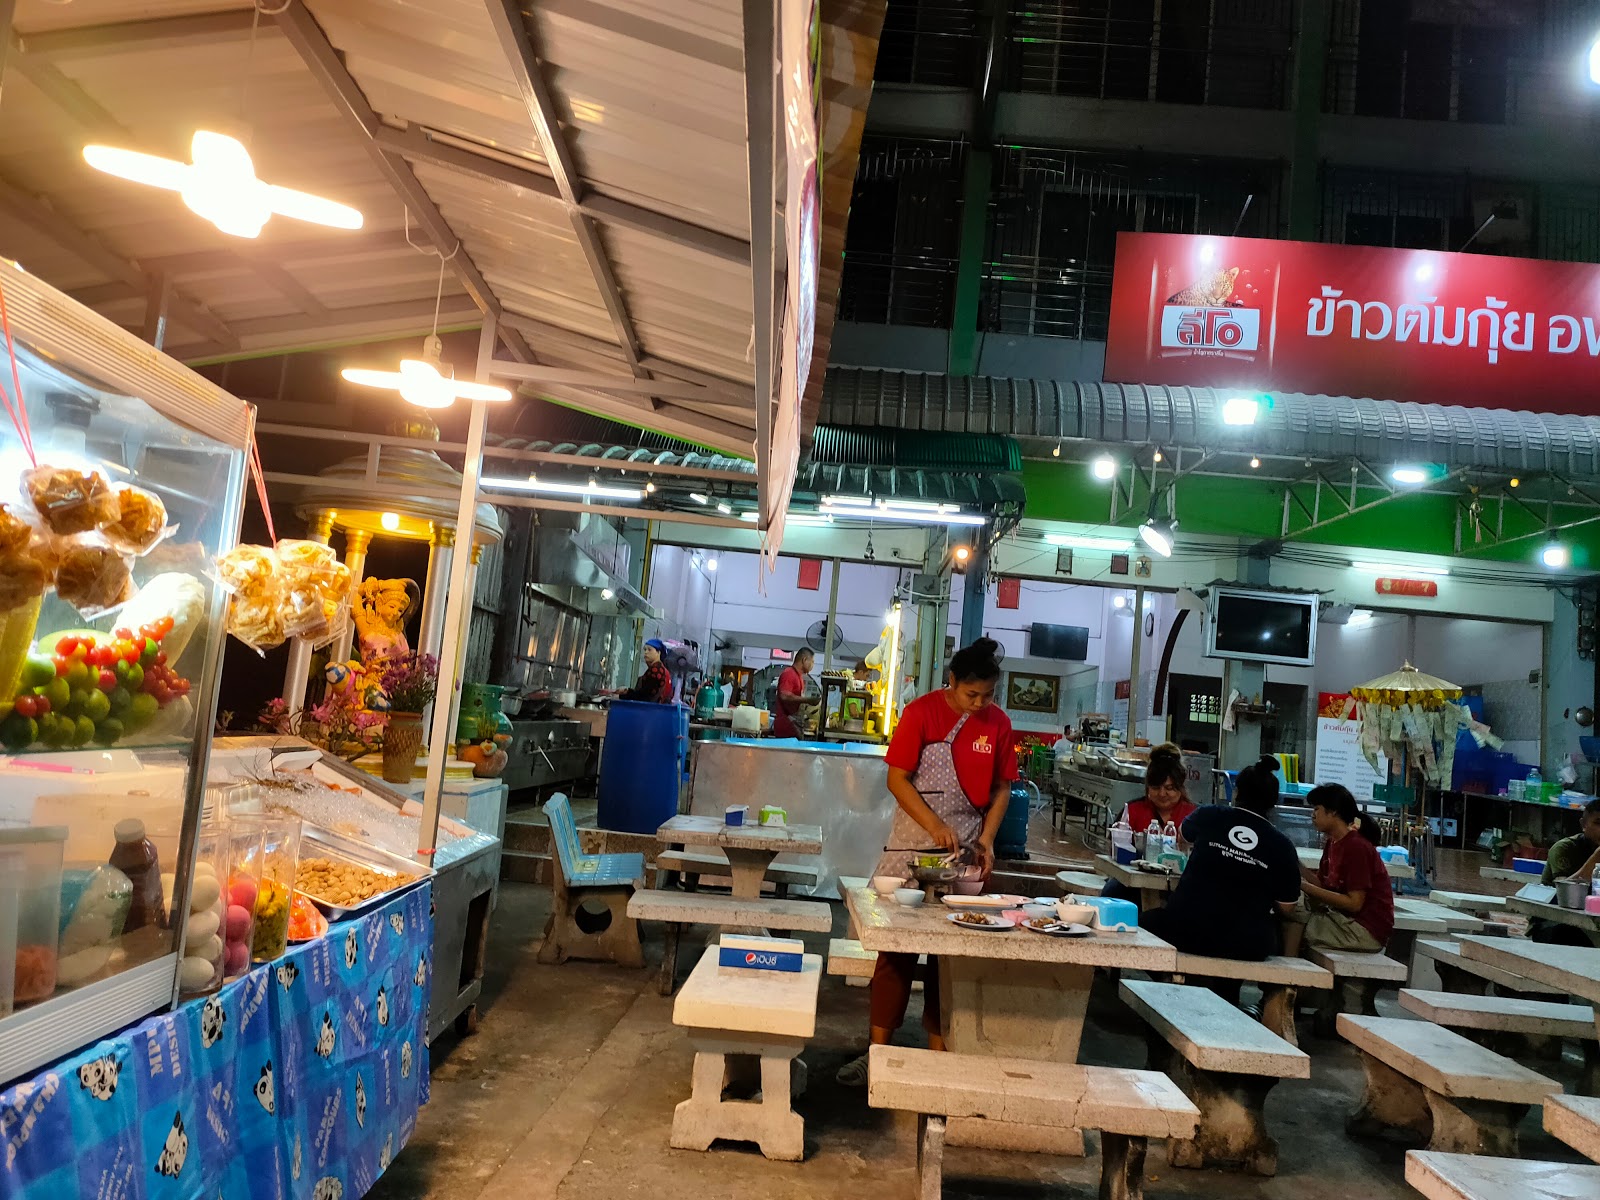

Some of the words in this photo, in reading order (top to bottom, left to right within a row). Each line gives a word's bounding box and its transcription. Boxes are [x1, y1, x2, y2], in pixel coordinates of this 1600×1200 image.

[1177, 308, 1243, 347] ลีโอ
[1306, 286, 1534, 364] ข้าวต้มกุ้ย
[973, 743, 991, 753] LEO
